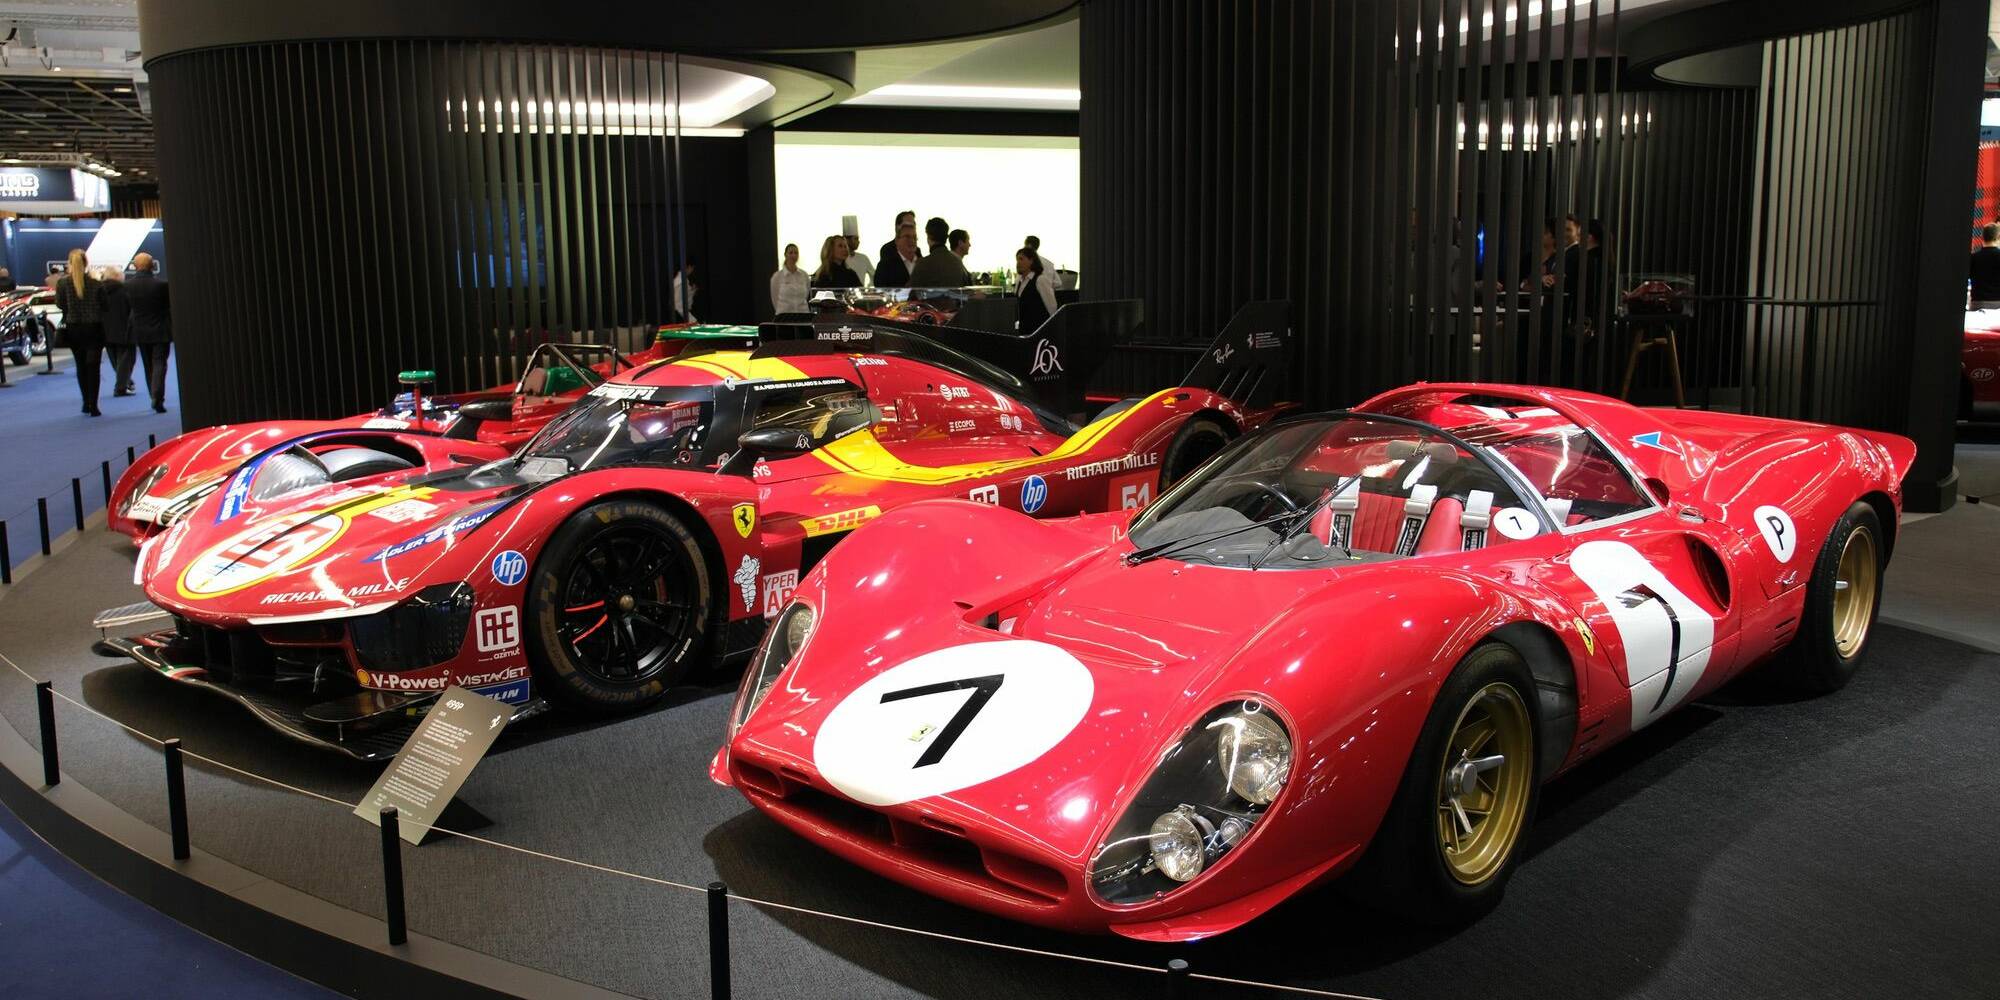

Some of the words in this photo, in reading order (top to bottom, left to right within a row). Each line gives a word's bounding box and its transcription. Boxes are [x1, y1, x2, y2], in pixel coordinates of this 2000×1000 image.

[851, 332, 873, 340] GROUP
[1066, 460, 1120, 480] RICHARD
[1123, 452, 1158, 470] MILLE
[1027, 481, 1044, 512] hp
[1121, 482, 1150, 512] 51
[814, 509, 874, 531] DHL
[1508, 515, 1523, 531] 7
[1766, 516, 1785, 551] P
[499, 551, 523, 585] hp
[346, 577, 410, 597] MILLE
[494, 648, 520, 661] azimut
[1615, 584, 1681, 714] 7
[371, 672, 449, 690] V-Power
[456, 666, 526, 686] VISTAJET
[879, 673, 1005, 769] 7
